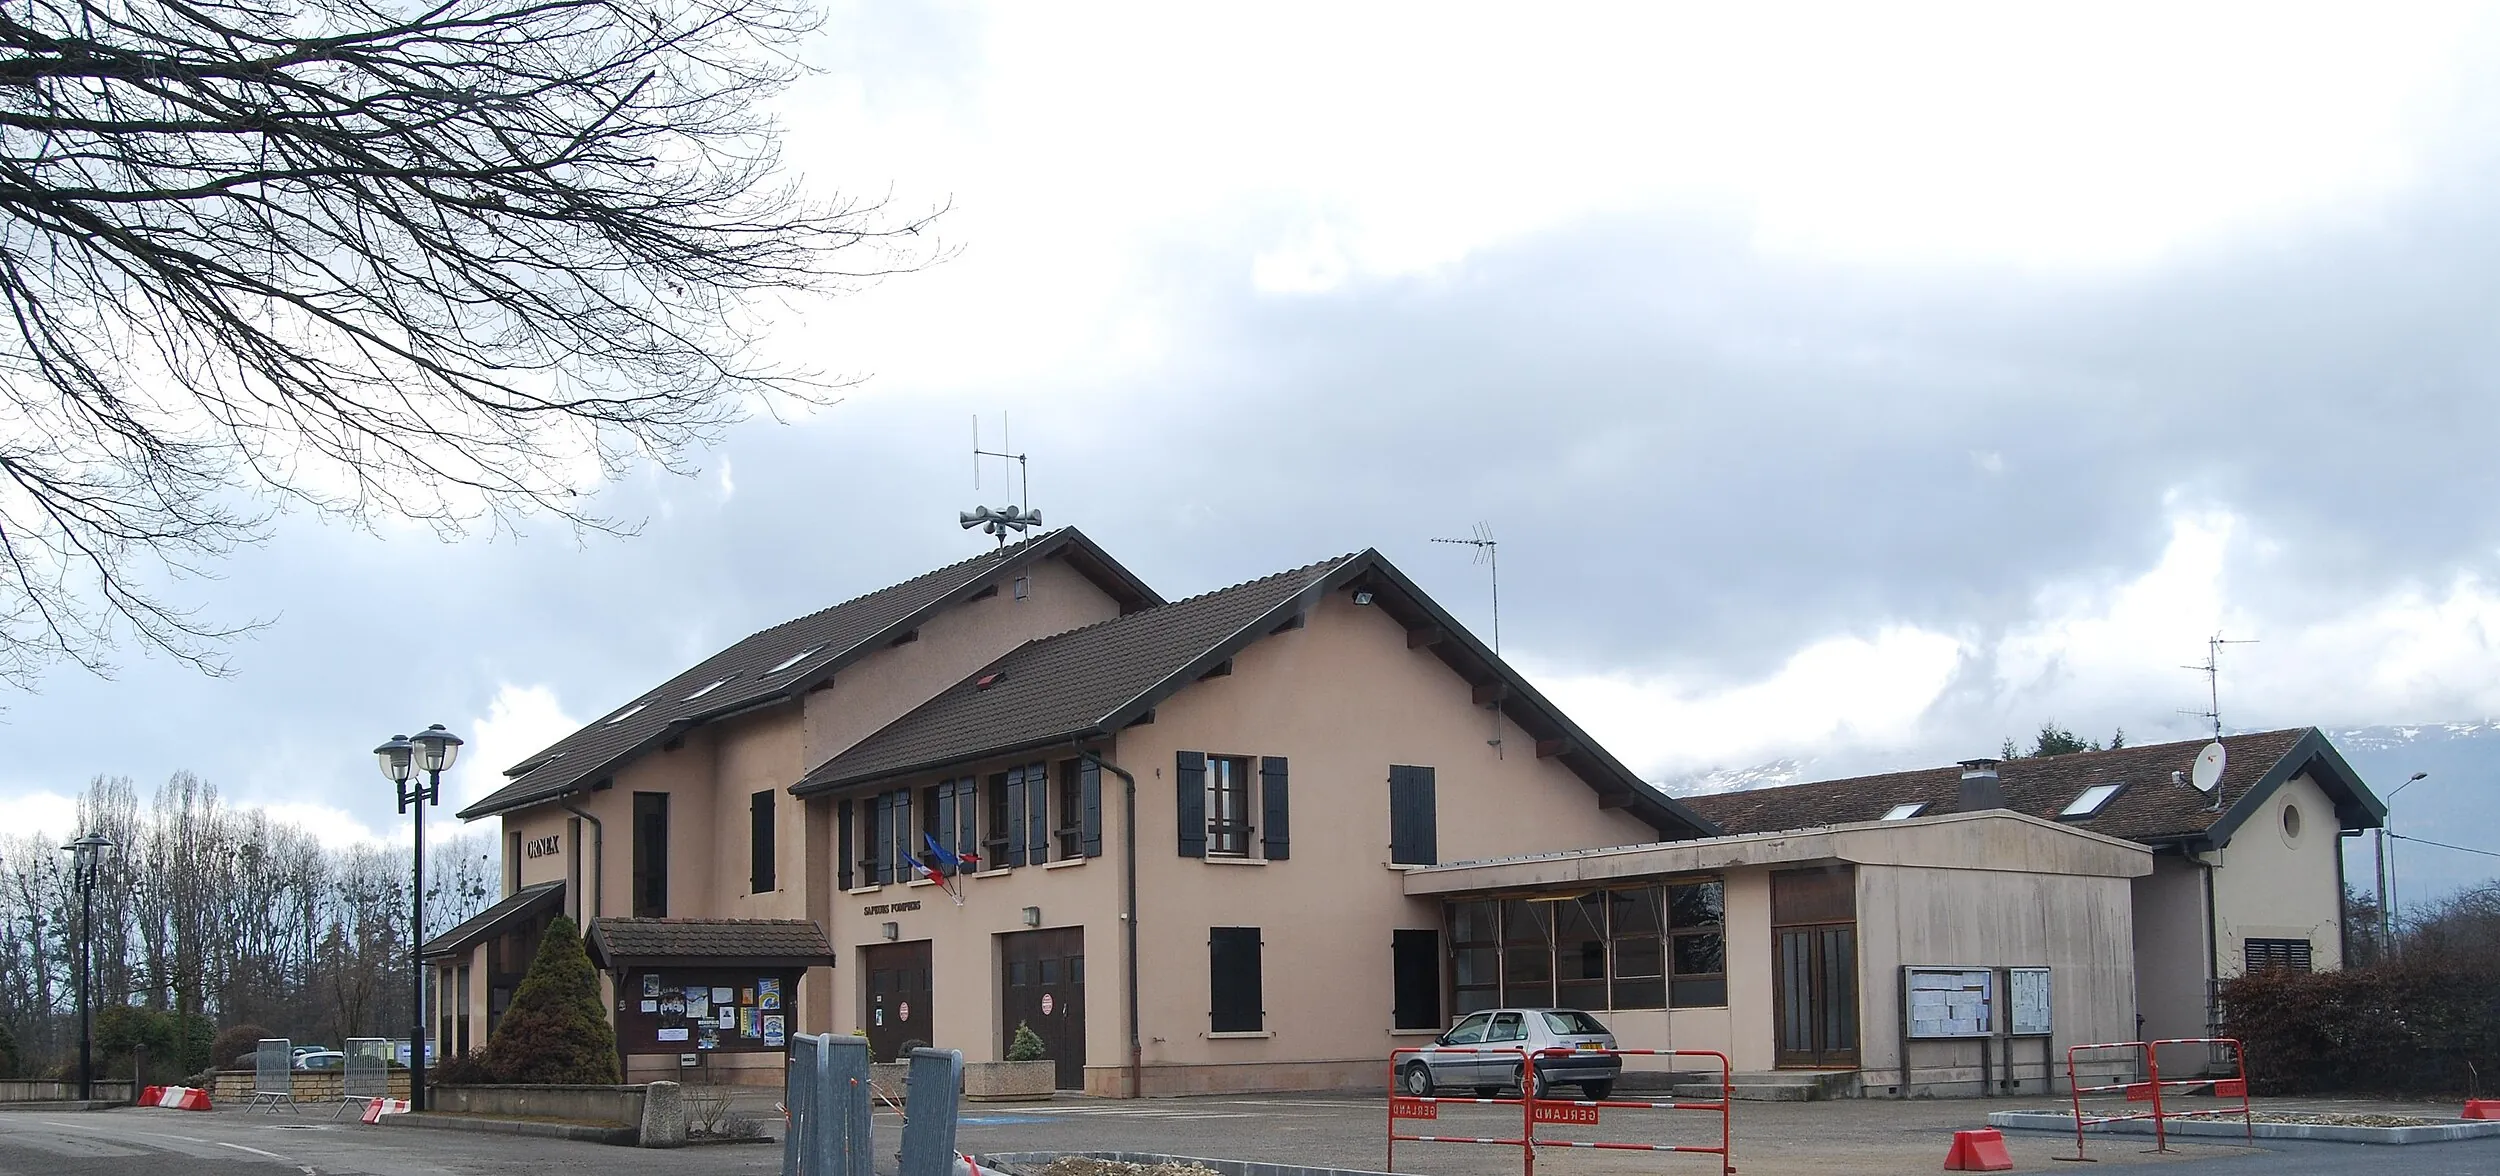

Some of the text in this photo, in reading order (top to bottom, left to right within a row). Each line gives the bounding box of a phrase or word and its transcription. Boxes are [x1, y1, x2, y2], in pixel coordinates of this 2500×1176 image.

[526, 835, 559, 859] ORNEX
[864, 900, 920, 916] SAPEURS POMPIERS
